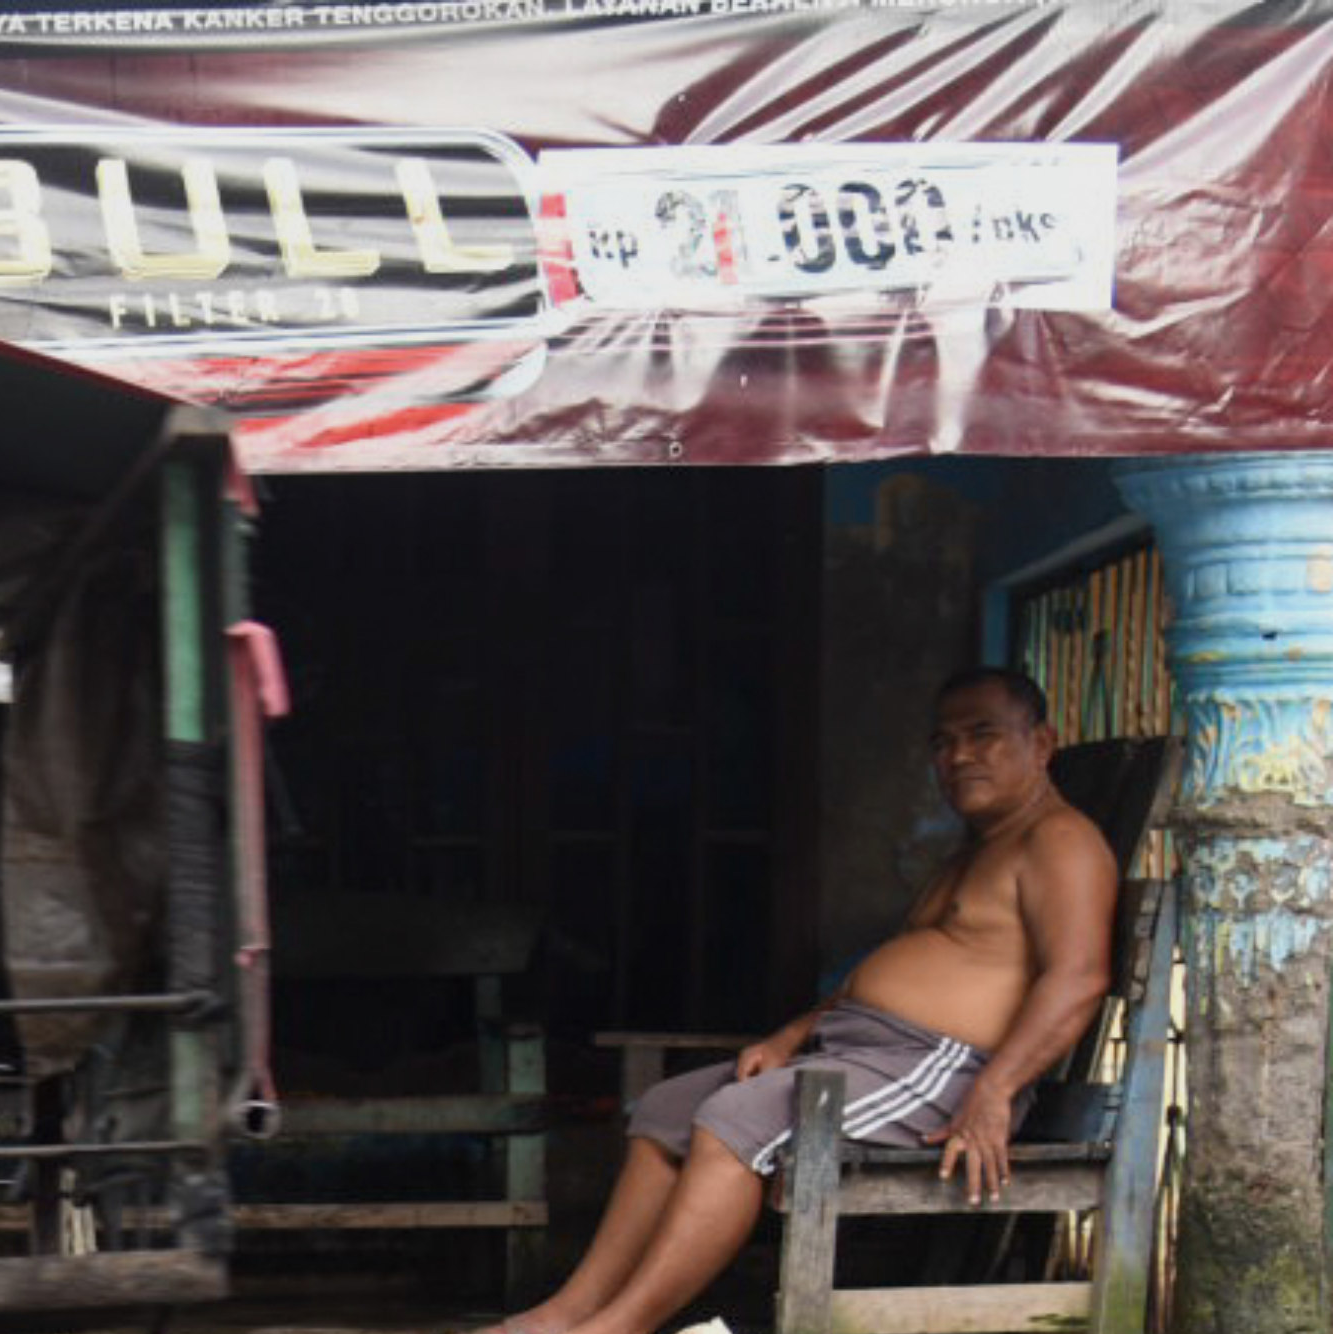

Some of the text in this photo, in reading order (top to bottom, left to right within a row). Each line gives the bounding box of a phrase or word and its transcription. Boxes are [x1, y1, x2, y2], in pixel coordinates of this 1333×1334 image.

[38, 9, 173, 33] TERKENA
[183, 7, 305, 30] KANKER
[108, 289, 279, 330] FILTER
